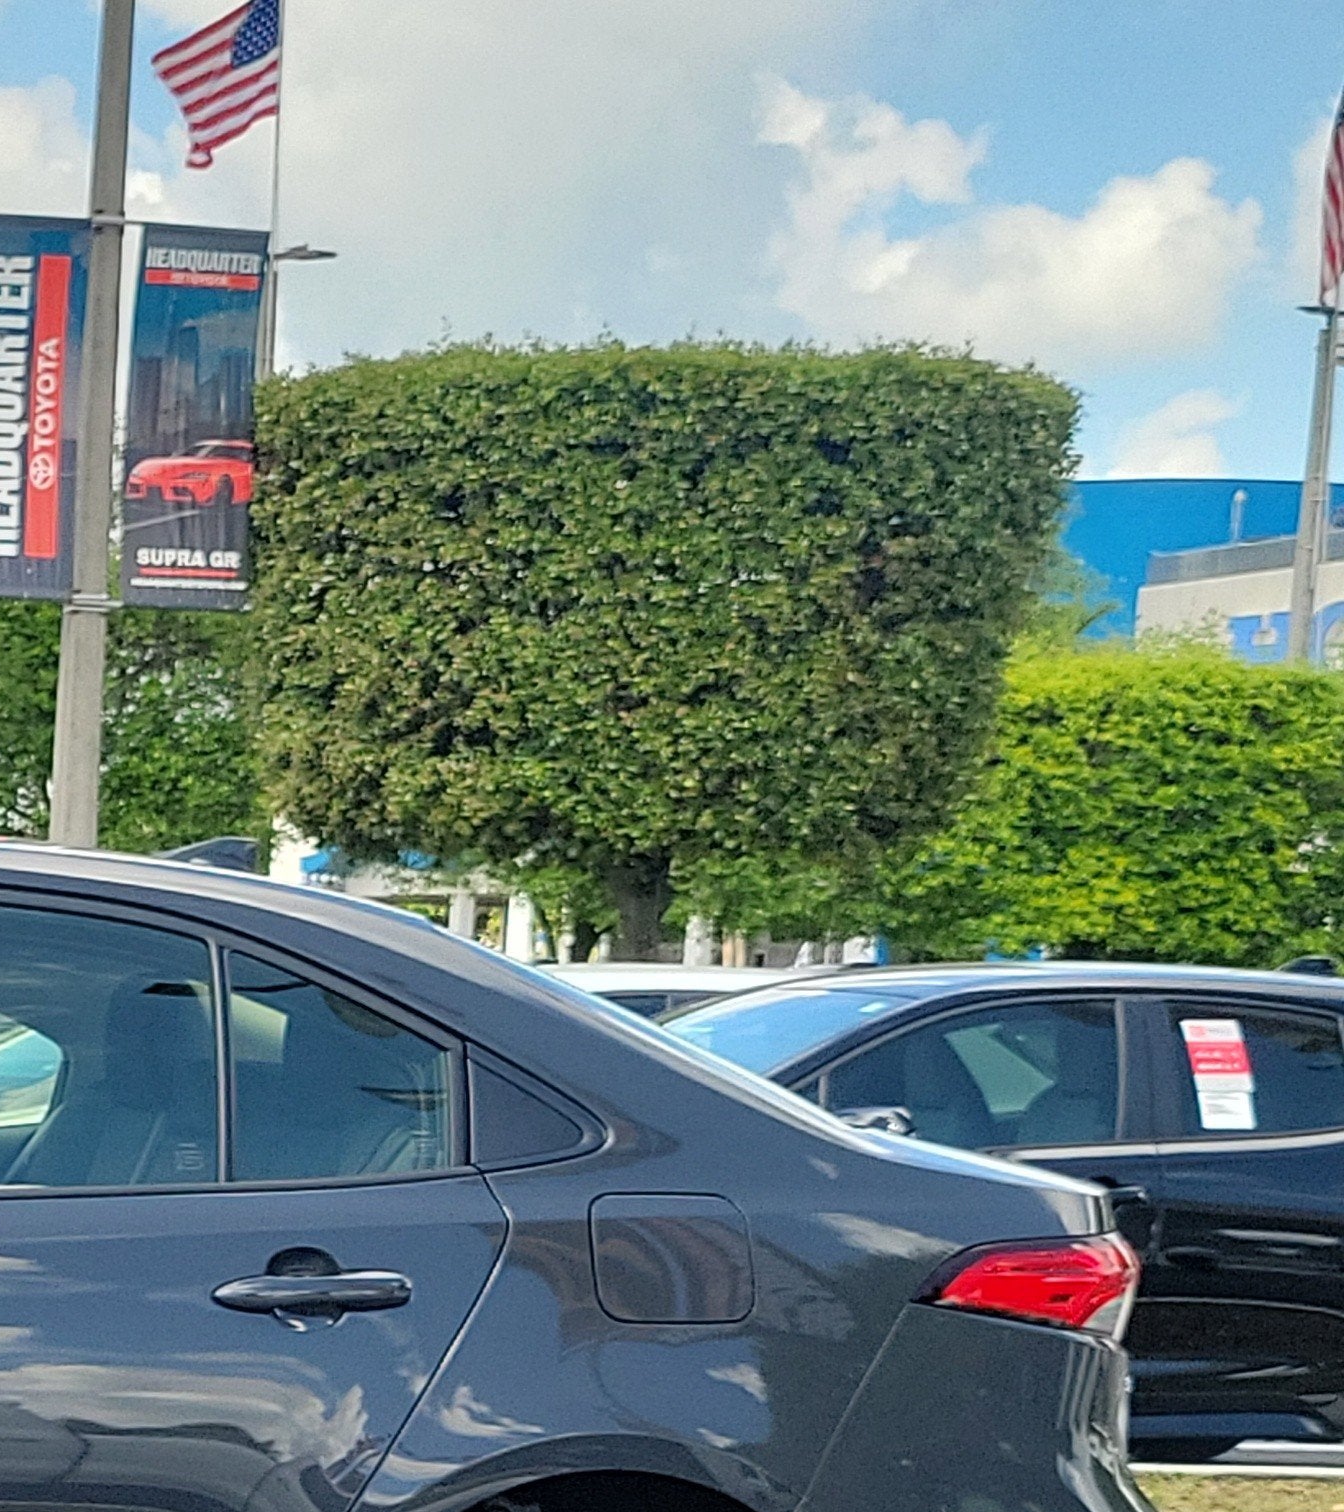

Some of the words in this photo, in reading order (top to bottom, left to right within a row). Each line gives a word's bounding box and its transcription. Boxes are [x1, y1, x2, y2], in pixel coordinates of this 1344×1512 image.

[33, 337, 60, 450] TOYOTA
[136, 547, 207, 568] SUPRA
[209, 550, 242, 569] GR
